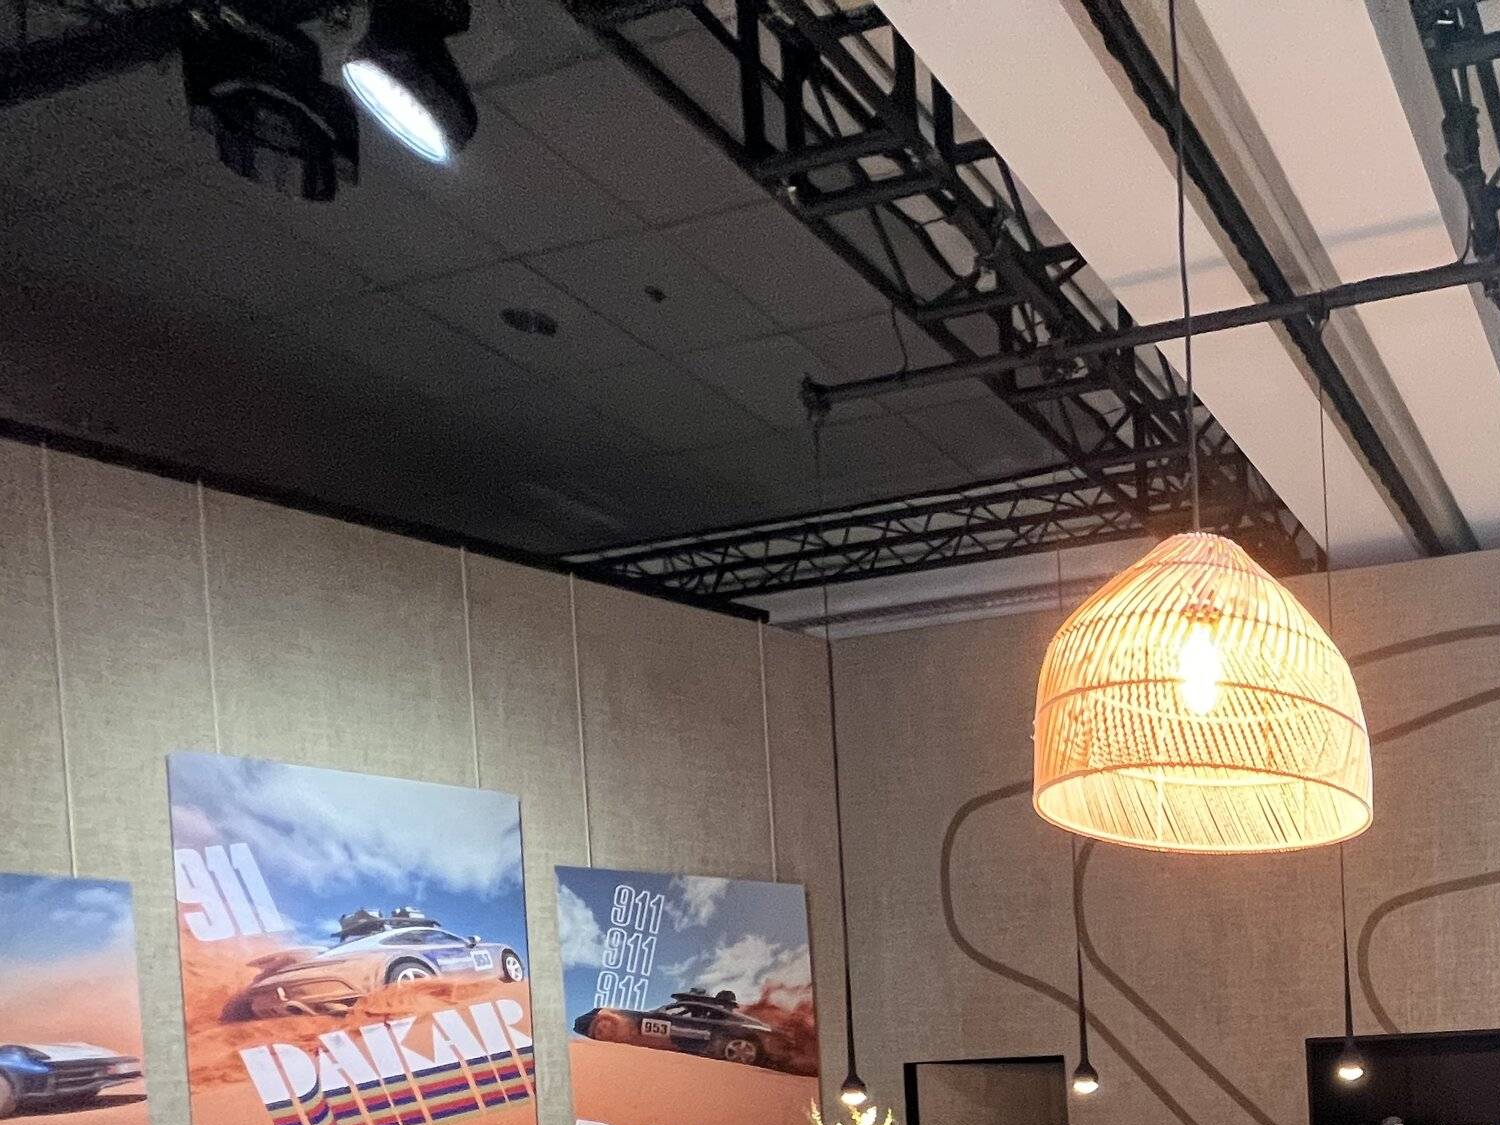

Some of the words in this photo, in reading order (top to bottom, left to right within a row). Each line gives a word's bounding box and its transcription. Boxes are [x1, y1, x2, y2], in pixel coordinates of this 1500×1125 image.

[174, 842, 287, 942] 911
[609, 883, 665, 934] 911
[602, 926, 656, 976] 911
[594, 970, 649, 1011] 911
[644, 1020, 668, 1036] 953
